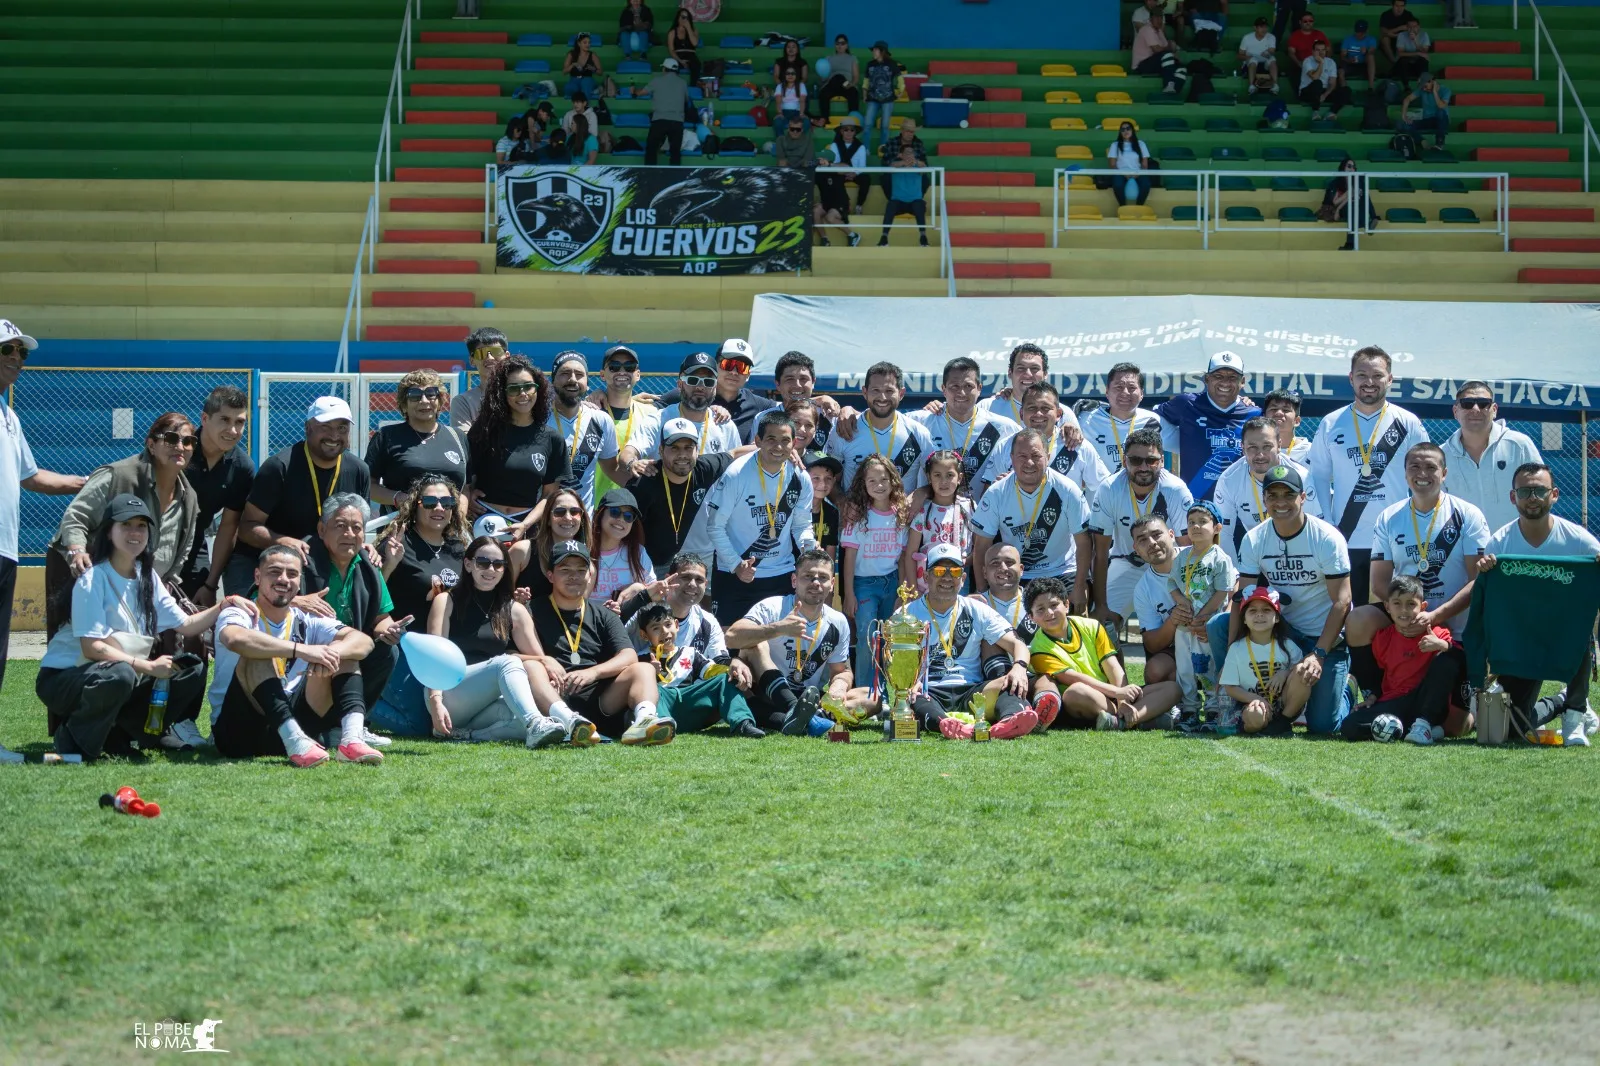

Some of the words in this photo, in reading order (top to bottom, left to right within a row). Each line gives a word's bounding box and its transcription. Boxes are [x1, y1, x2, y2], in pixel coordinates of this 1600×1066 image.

[584, 194, 604, 206] 23
[625, 208, 657, 225] LOS
[611, 224, 758, 256] CUERVOS
[755, 215, 805, 254] 23
[536, 241, 580, 250] CUERVOS23
[548, 249, 568, 257] AQP
[682, 261, 717, 274] AQP
[1002, 327, 1151, 348] Trabajamos
[1227, 325, 1258, 336] un
[1264, 328, 1358, 347] distrito
[1145, 371, 1333, 396] DISRITAL
[1411, 376, 1591, 407] SAHACA
[872, 532, 898, 543] CLUB
[1275, 559, 1303, 570] CLUB
